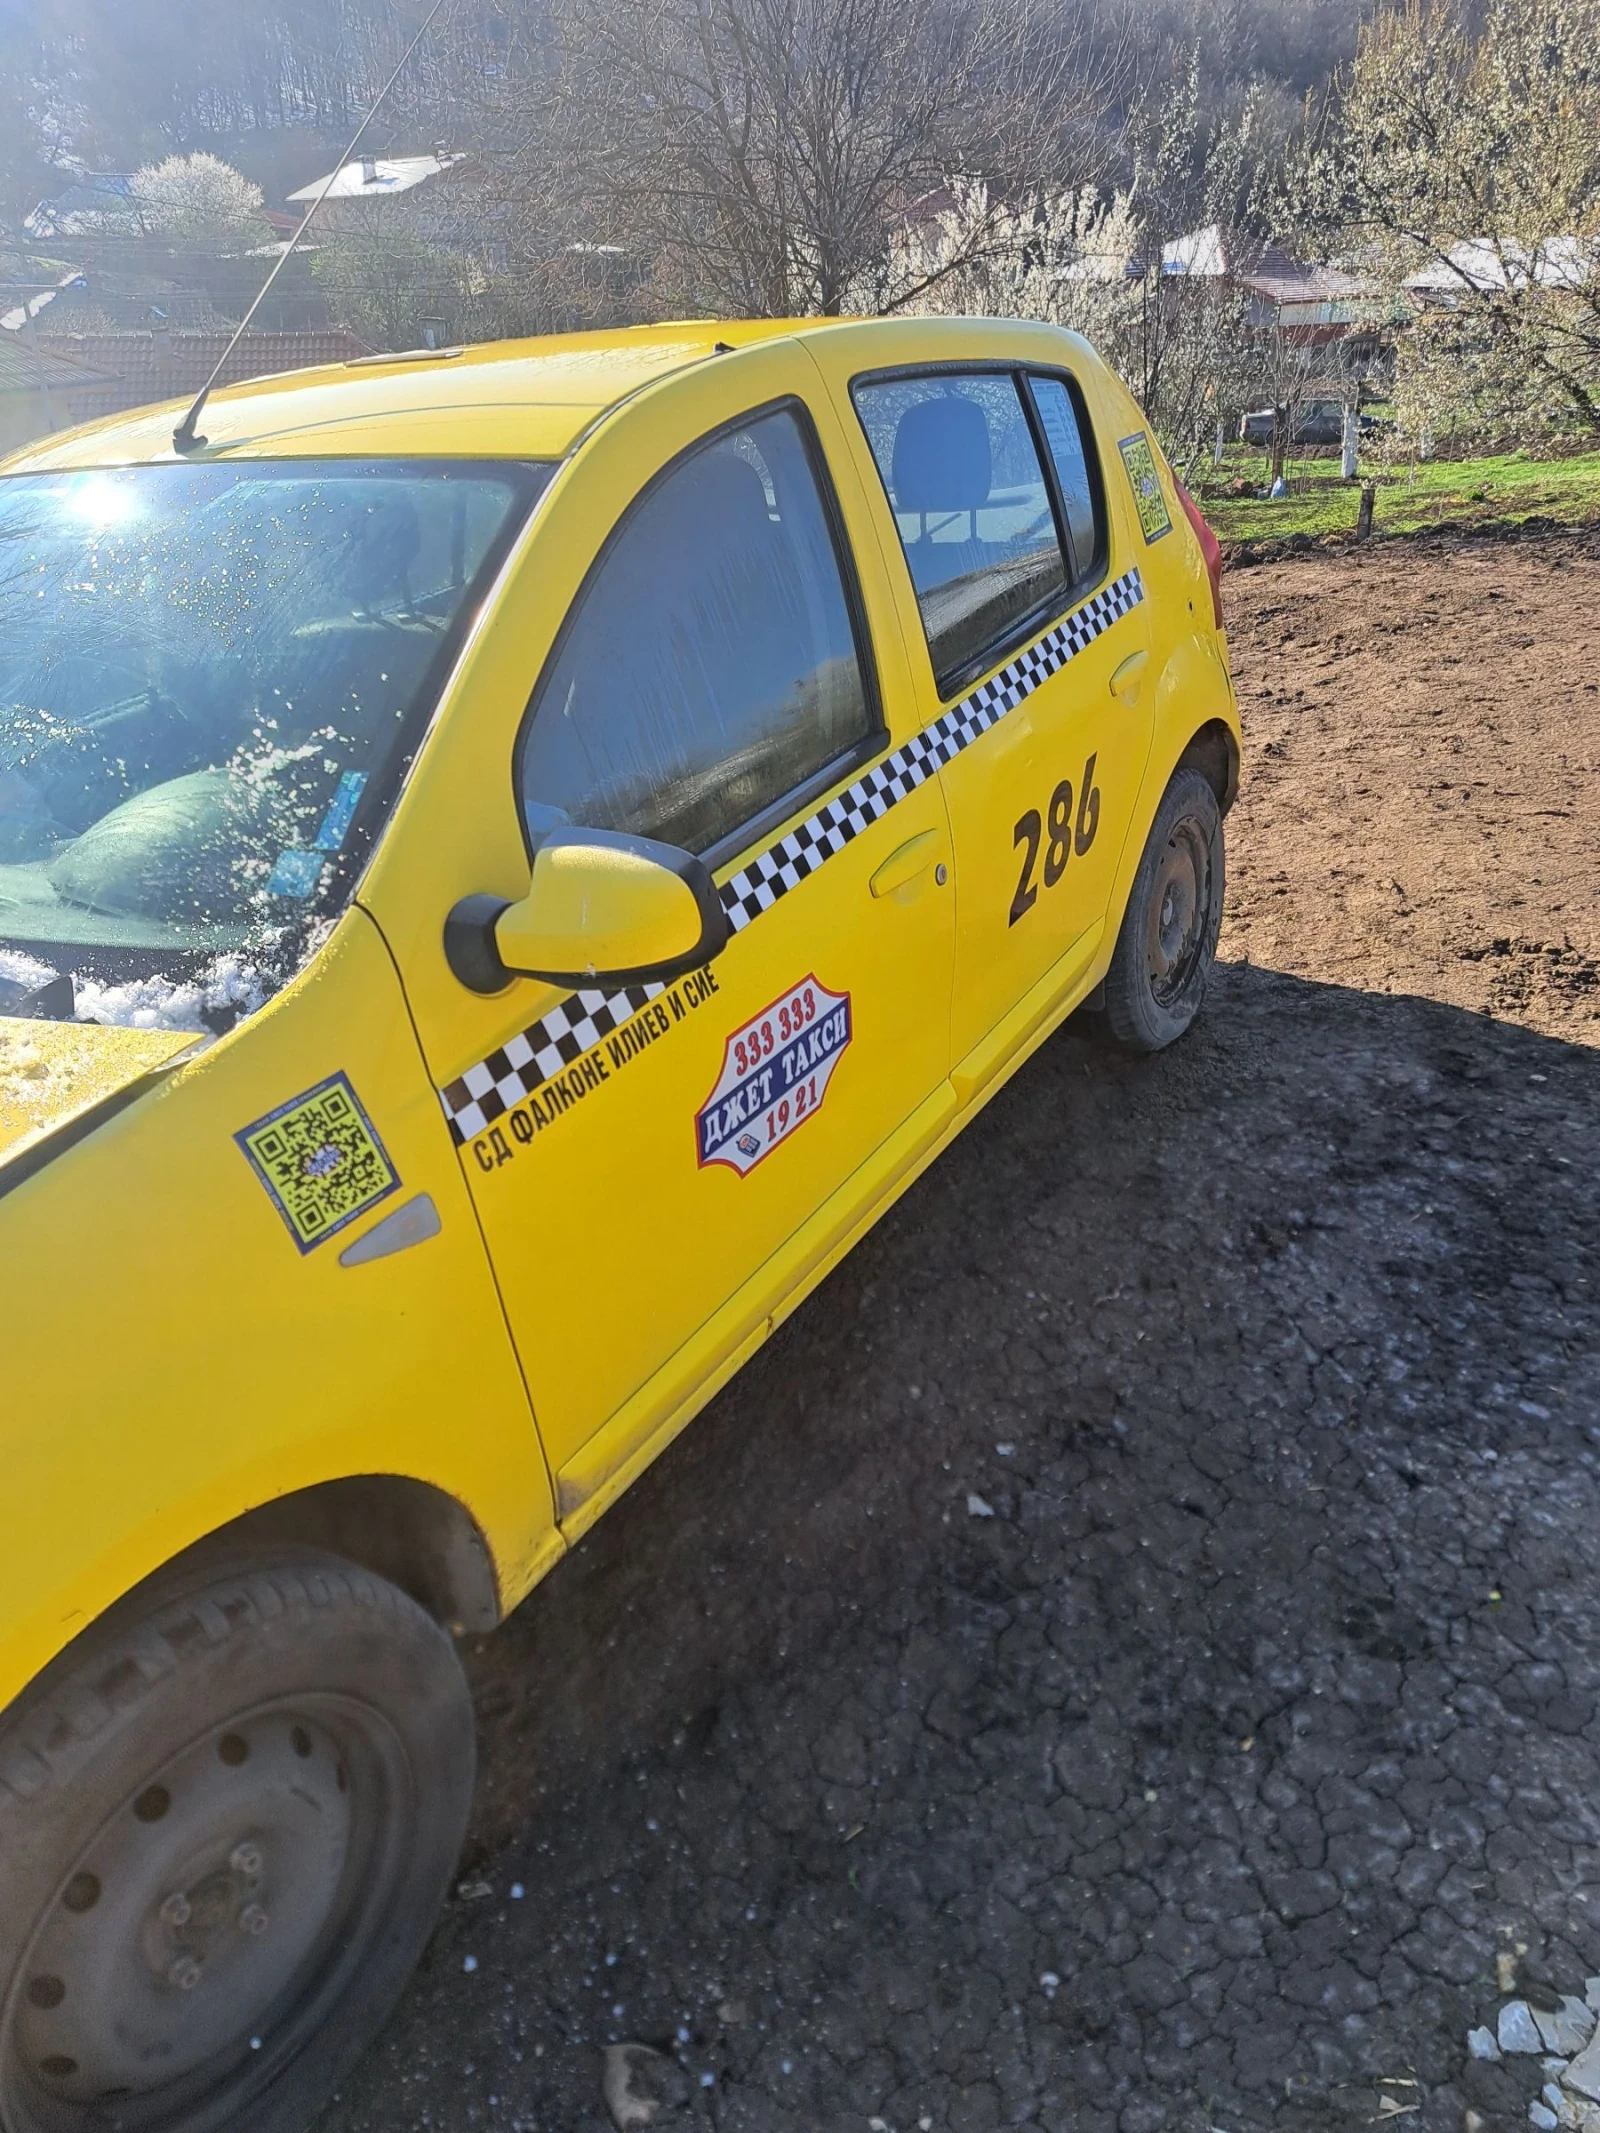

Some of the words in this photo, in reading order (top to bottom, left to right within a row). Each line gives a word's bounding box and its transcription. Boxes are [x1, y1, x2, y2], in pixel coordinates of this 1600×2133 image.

[1009, 751, 1100, 928] 286
[472, 1126, 514, 1173] СД
[509, 1049, 611, 1145] ФАЛКОНЕ
[605, 1003, 671, 1070] ИЛИЕВ
[666, 990, 687, 1022] И
[683, 962, 720, 1009] СИЕ
[704, 1067, 773, 1154] ДЖЕТ
[781, 1006, 846, 1085] ТАКСИ
[734, 1021, 774, 1076] 333
[778, 988, 816, 1041] 333
